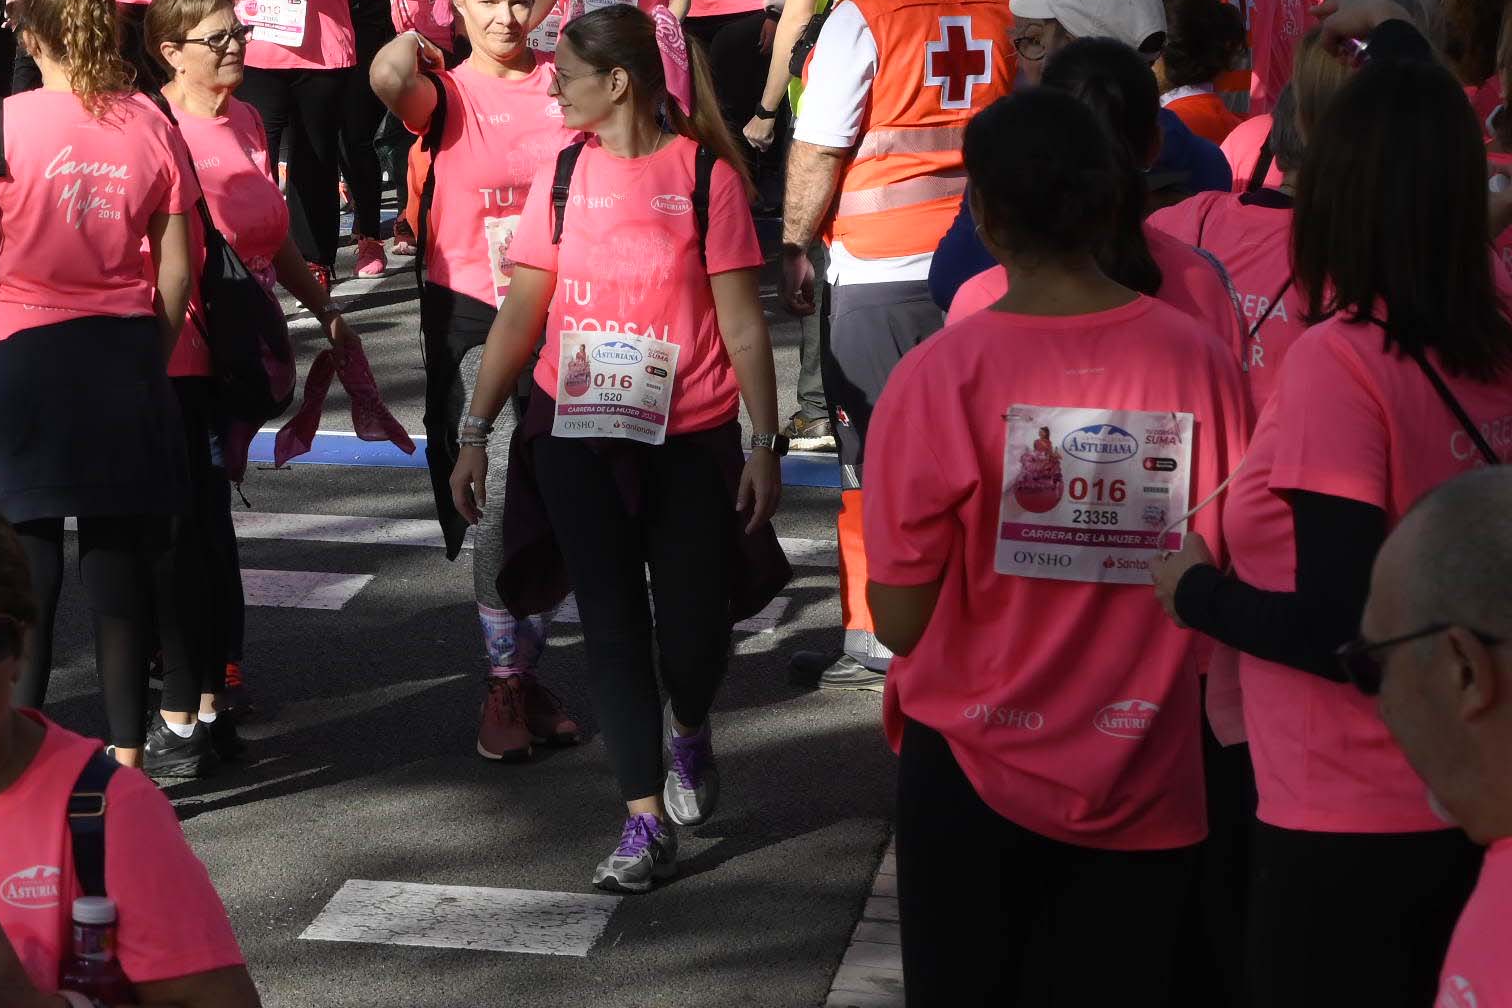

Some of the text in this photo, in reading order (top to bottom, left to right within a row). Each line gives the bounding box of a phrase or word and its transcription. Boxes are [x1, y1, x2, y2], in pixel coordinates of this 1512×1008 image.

[45, 146, 133, 180] Carrera
[57, 179, 113, 229] Mujer
[479, 187, 513, 208] TU
[98, 210, 121, 220] 2018
[564, 279, 591, 305] TU
[596, 349, 638, 362] ASTURIANA
[594, 373, 633, 389] 016
[599, 393, 622, 402] 1520
[616, 407, 640, 416] MUJER
[564, 421, 595, 431] OYSHO
[621, 422, 656, 435] Santander
[1069, 437, 1132, 455] ASTURIANA
[1145, 435, 1177, 446] SUMA
[1068, 477, 1126, 502] 016
[1072, 509, 1118, 525] 23358
[1021, 528, 1072, 541] CARRERA
[1076, 532, 1090, 542] DE
[1093, 533, 1105, 543] LA
[1108, 534, 1141, 545] MUJER
[1014, 551, 1072, 567] OYSHO
[7, 883, 58, 899] ASTURIA
